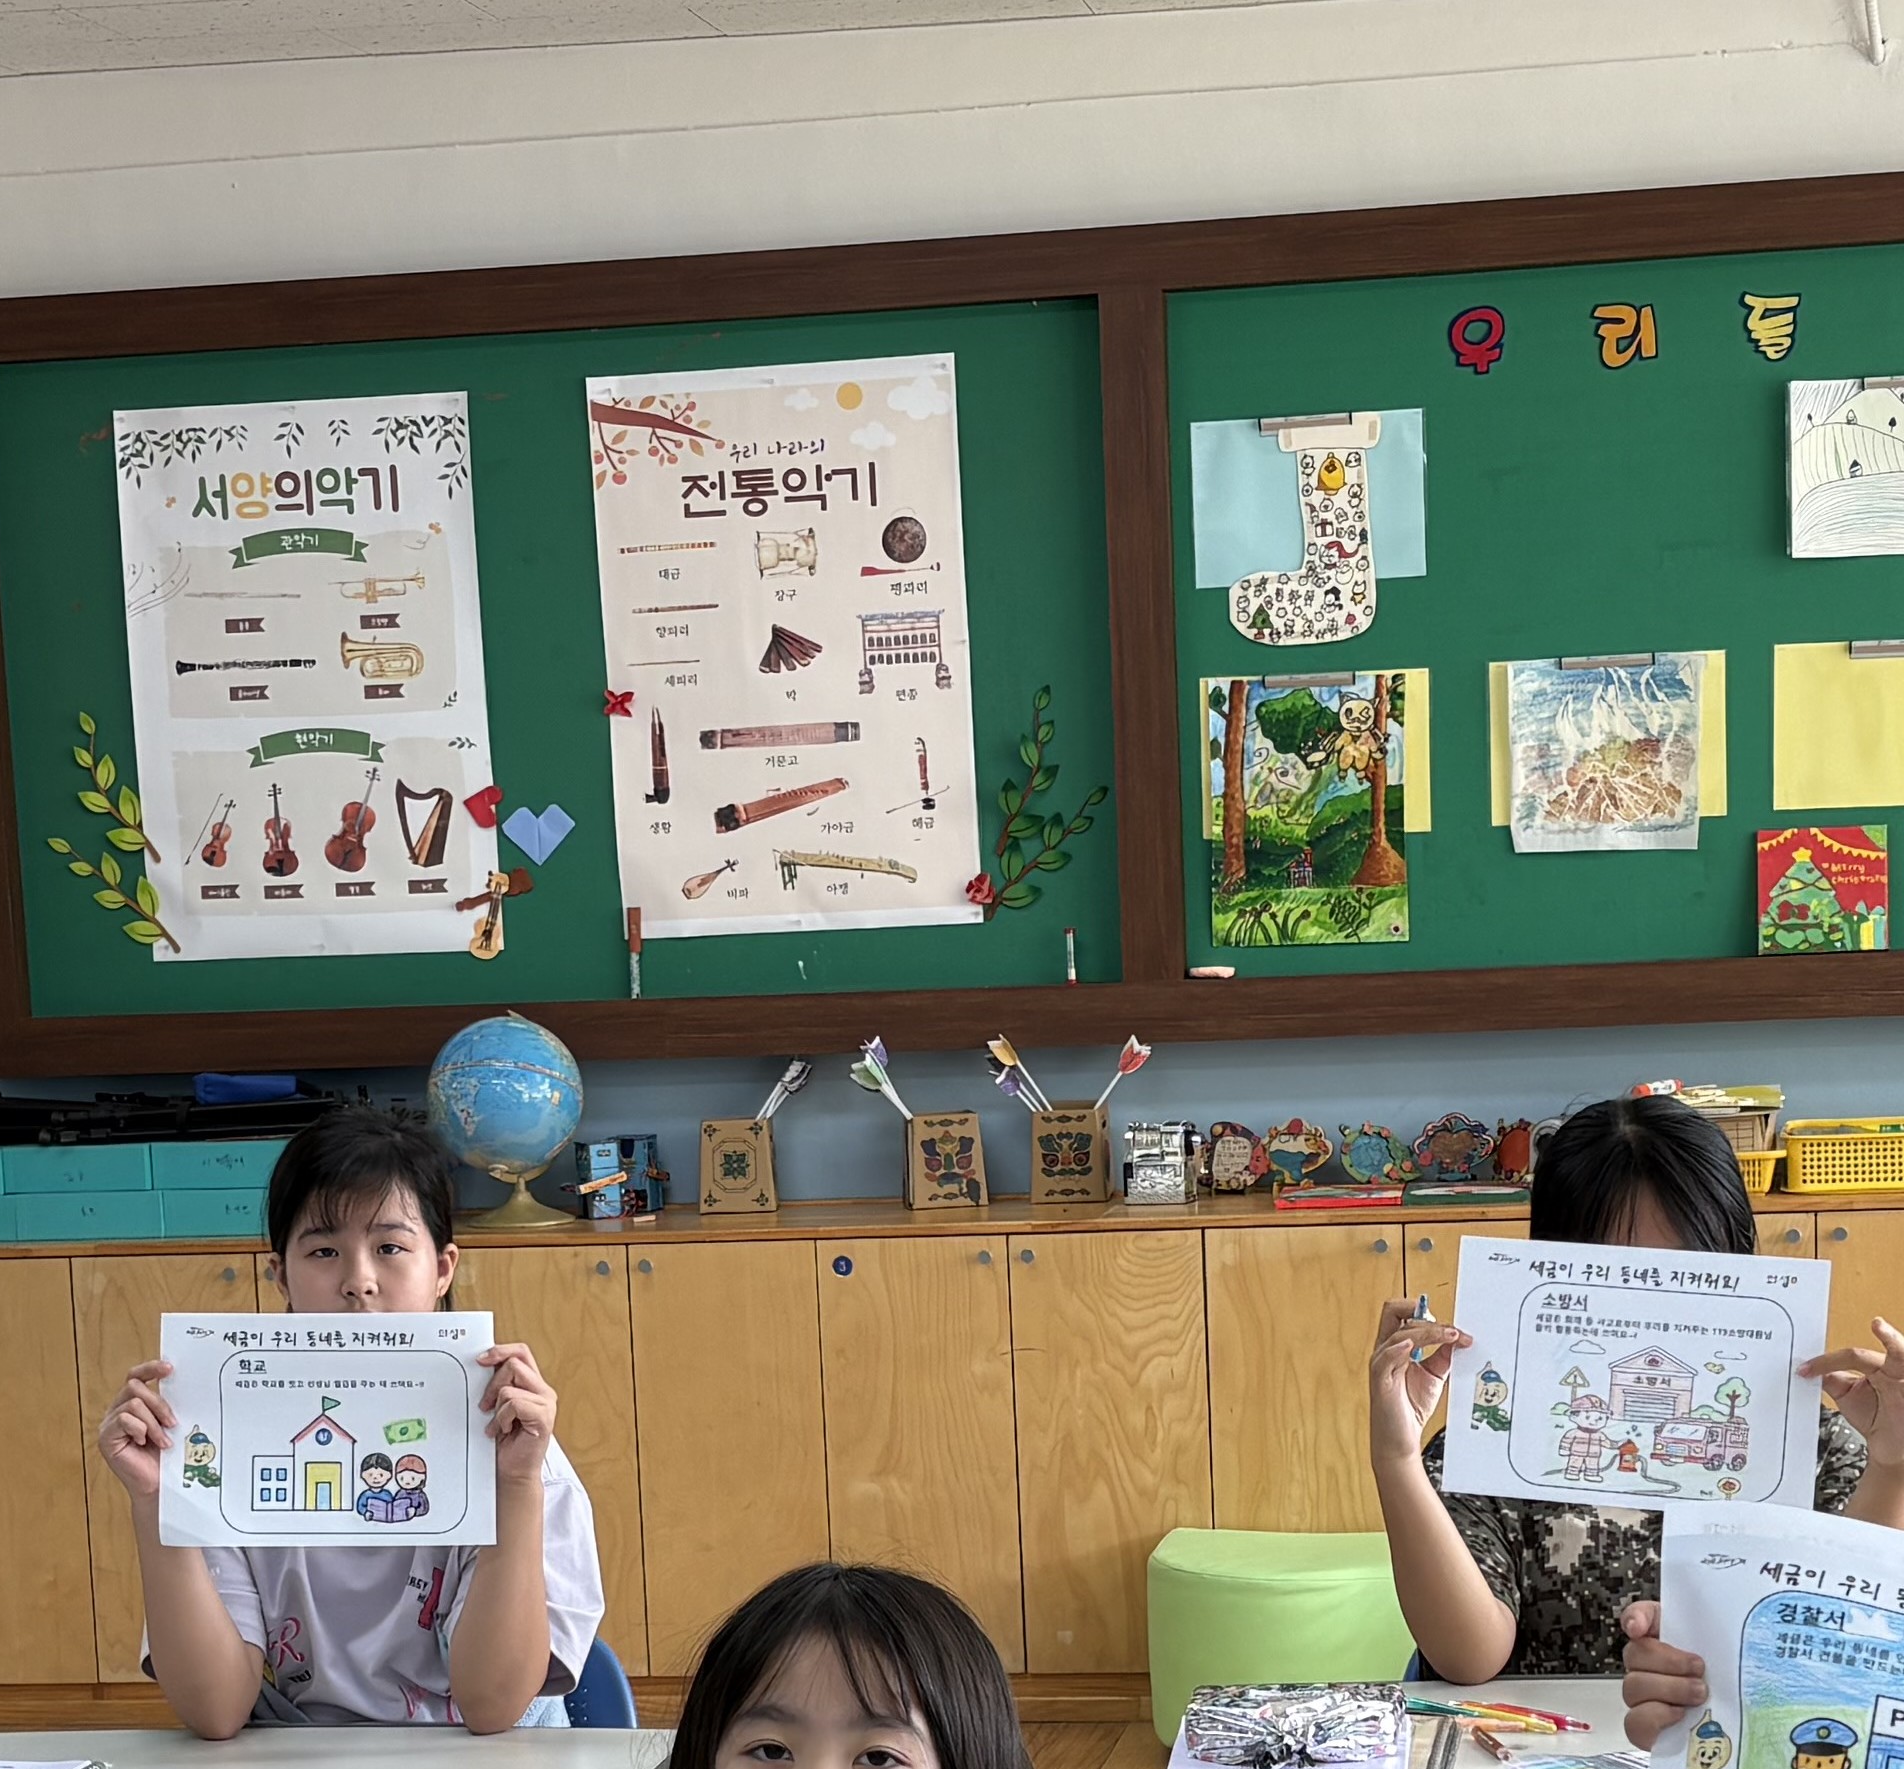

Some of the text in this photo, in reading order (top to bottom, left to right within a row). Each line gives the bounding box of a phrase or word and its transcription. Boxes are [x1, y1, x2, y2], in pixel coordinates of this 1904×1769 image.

[192, 464, 399, 520] 서양의악기
[680, 462, 878, 518] 전통악기
[280, 533, 319, 550] 관악기
[775, 589, 797, 601] 장구
[294, 731, 334, 749] 현악기
[765, 755, 799, 768] 거문고
[912, 817, 935, 830] 해금
[727, 887, 749, 899] 비파
[1529, 1260, 1573, 1279] 세금이
[1581, 1264, 1610, 1282] 우리
[1621, 1266, 1664, 1287] 동네를
[1542, 1293, 1588, 1311] 소방서
[222, 1332, 263, 1347] 세금이
[271, 1331, 297, 1347] 우리
[307, 1330, 347, 1348] 동네를
[239, 1359, 267, 1372] 학교
[1633, 1375, 1672, 1388] 소방서
[1759, 1561, 1824, 1591] 세금이
[1838, 1573, 1881, 1602] 우리
[1776, 1601, 1846, 1631] 경찰서
[1776, 1632, 1815, 1646] 세금은
[1822, 1637, 1846, 1651] 우리
[1853, 1642, 1890, 1660] 동네를
[1775, 1647, 1813, 1660] 경찰서
[1818, 1650, 1857, 1666] 건물을
